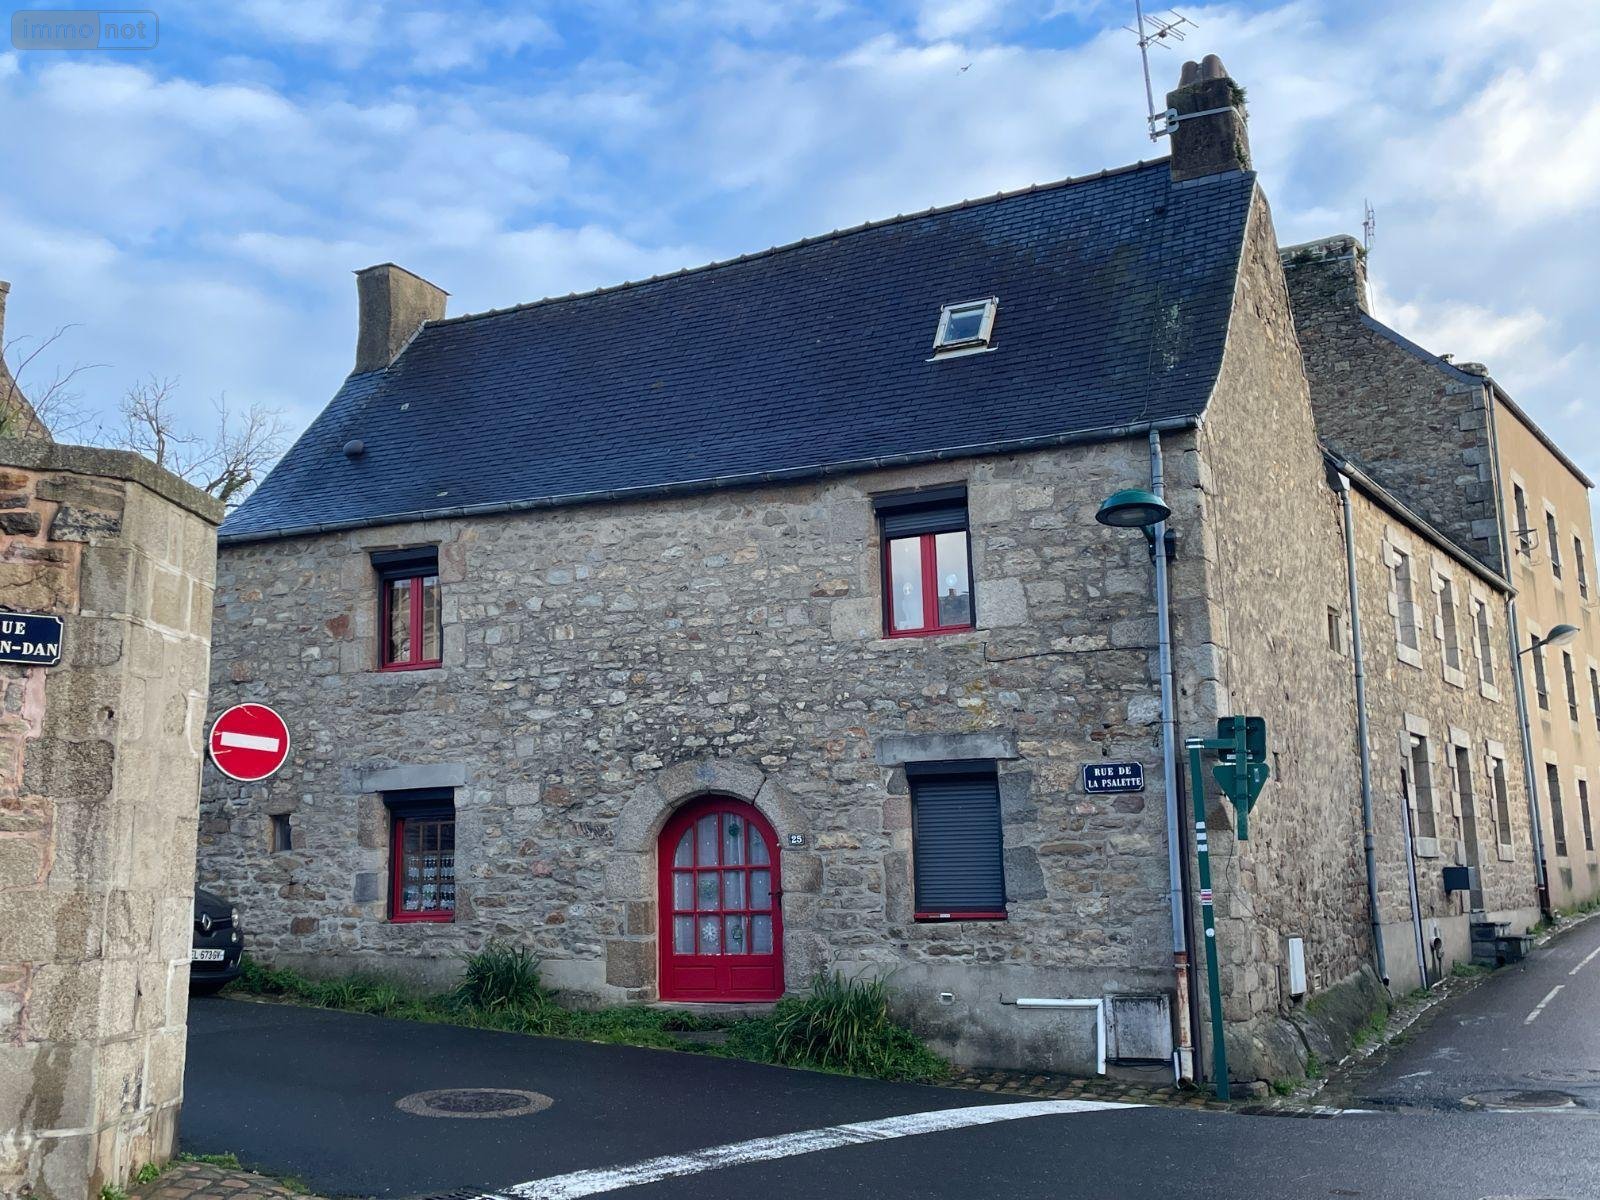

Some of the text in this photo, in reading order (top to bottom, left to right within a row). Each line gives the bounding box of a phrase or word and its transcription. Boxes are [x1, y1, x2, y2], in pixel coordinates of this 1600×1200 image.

[1094, 766, 1132, 777] RUE DE
[1088, 777, 1142, 788] LA PSALETTE
[791, 835, 802, 844] 25
